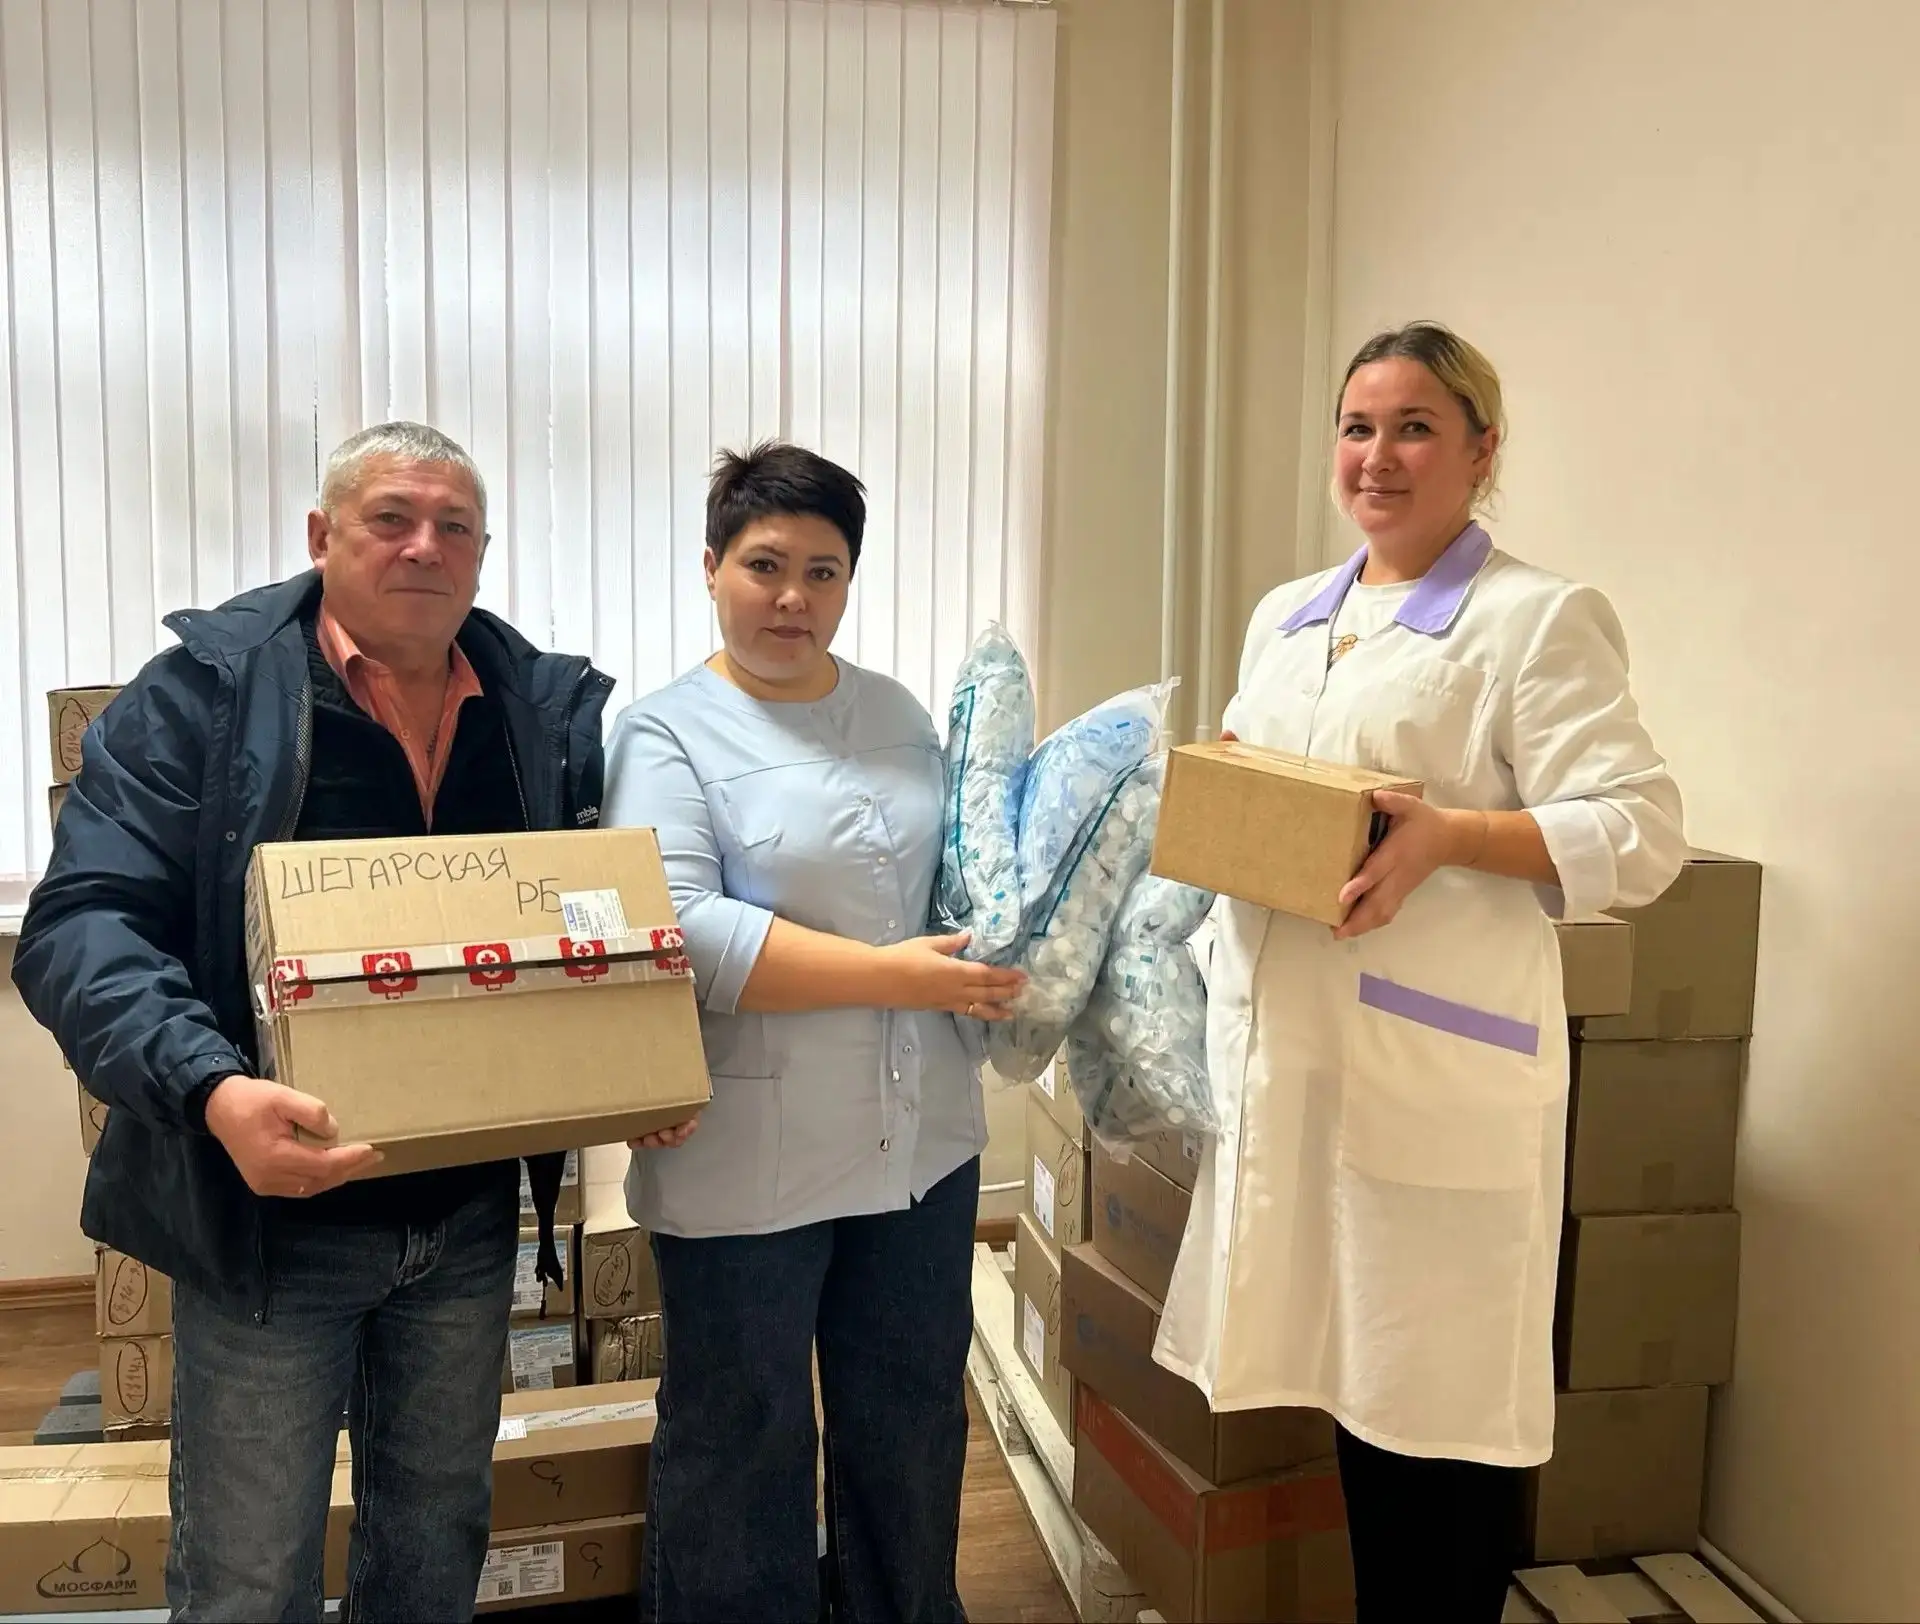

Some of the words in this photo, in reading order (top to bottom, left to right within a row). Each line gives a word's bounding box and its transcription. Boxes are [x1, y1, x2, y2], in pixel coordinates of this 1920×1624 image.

[281, 847, 512, 900] ШЕГАРСКАЯ
[516, 877, 564, 915] РБ
[54, 1579, 137, 1593] МОСФАРМ
